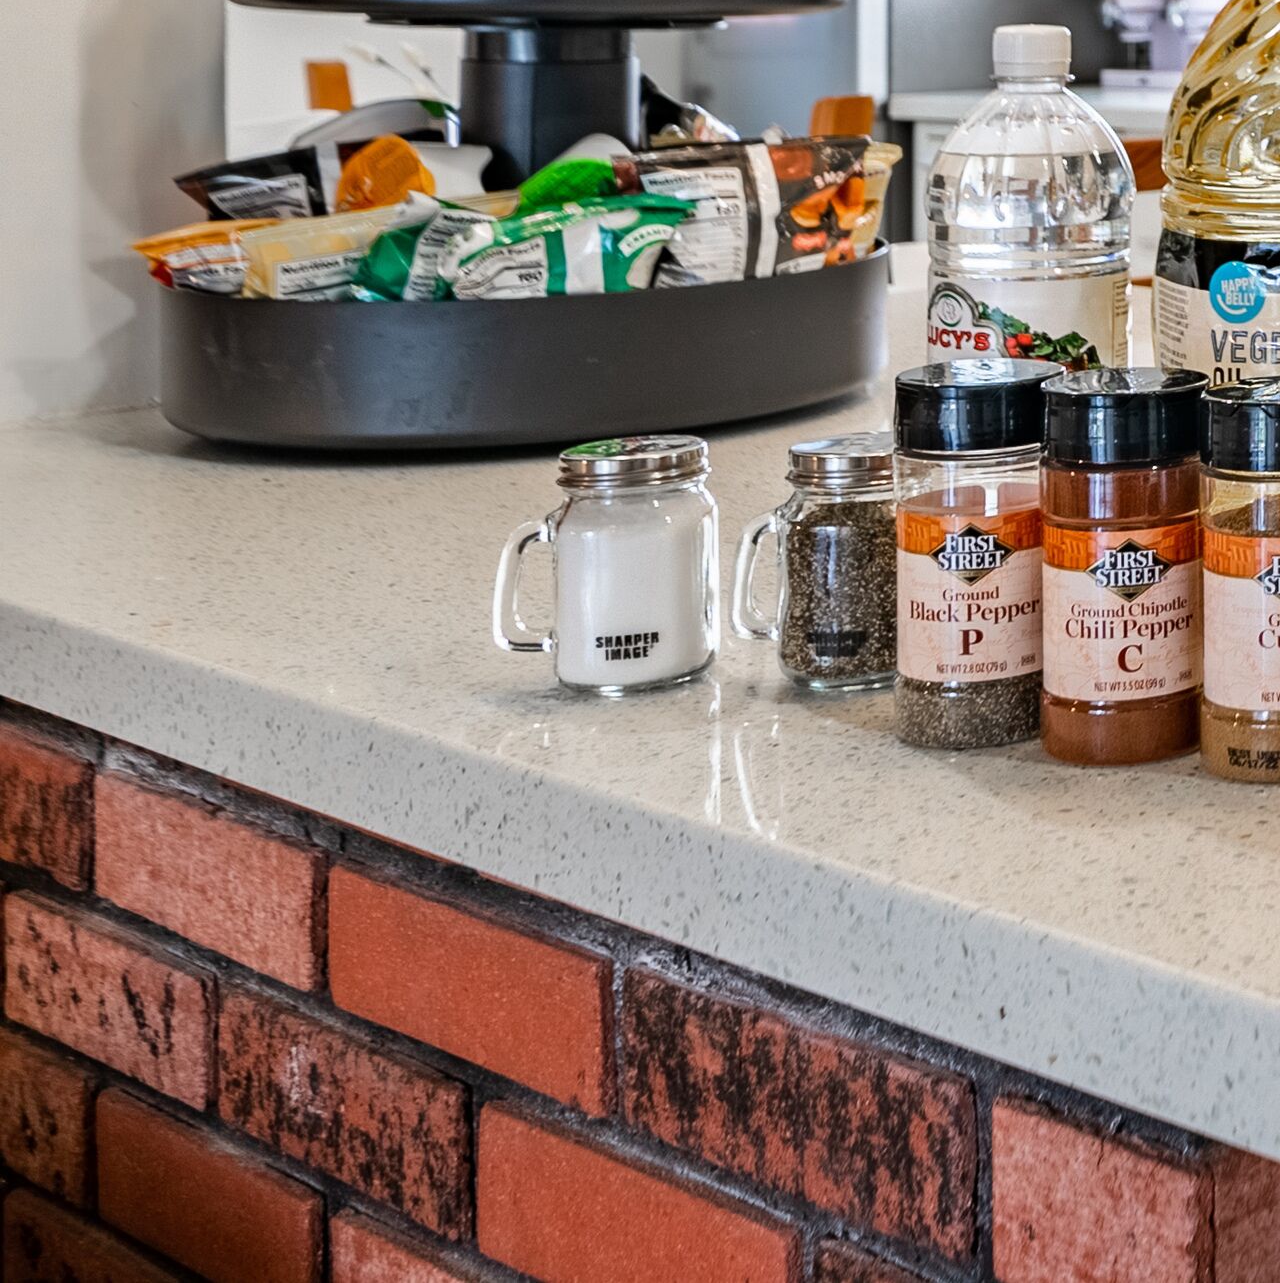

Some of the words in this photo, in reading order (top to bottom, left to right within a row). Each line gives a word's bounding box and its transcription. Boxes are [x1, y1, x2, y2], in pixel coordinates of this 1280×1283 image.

[1221, 277, 1255, 292] HAPPY
[1225, 292, 1257, 306] BELLY
[928, 324, 990, 351] UCY'S
[945, 533, 998, 553] FIRST
[938, 551, 1005, 570] STREET
[1103, 549, 1157, 569] FIRST
[1095, 566, 1164, 587] STREET
[942, 586, 1000, 602] Ground
[910, 600, 960, 622] Black
[966, 599, 1040, 625] Pepper
[1071, 603, 1125, 618] Ground
[1128, 596, 1188, 618] Chipotle
[1065, 618, 1114, 639] Chili
[1123, 614, 1194, 640] Pepper
[595, 632, 659, 648] SHARPER
[959, 629, 984, 656] P
[605, 645, 649, 661] IMAGE
[1117, 644, 1144, 673] C
[936, 664, 949, 674] NET
[951, 663, 962, 674] WT
[963, 662, 974, 673] 2.8
[975, 662, 985, 673] OZ
[1094, 681, 1107, 692] NET
[1110, 681, 1121, 691] WT
[1134, 680, 1144, 690] OZ
[1261, 692, 1274, 702] NET
